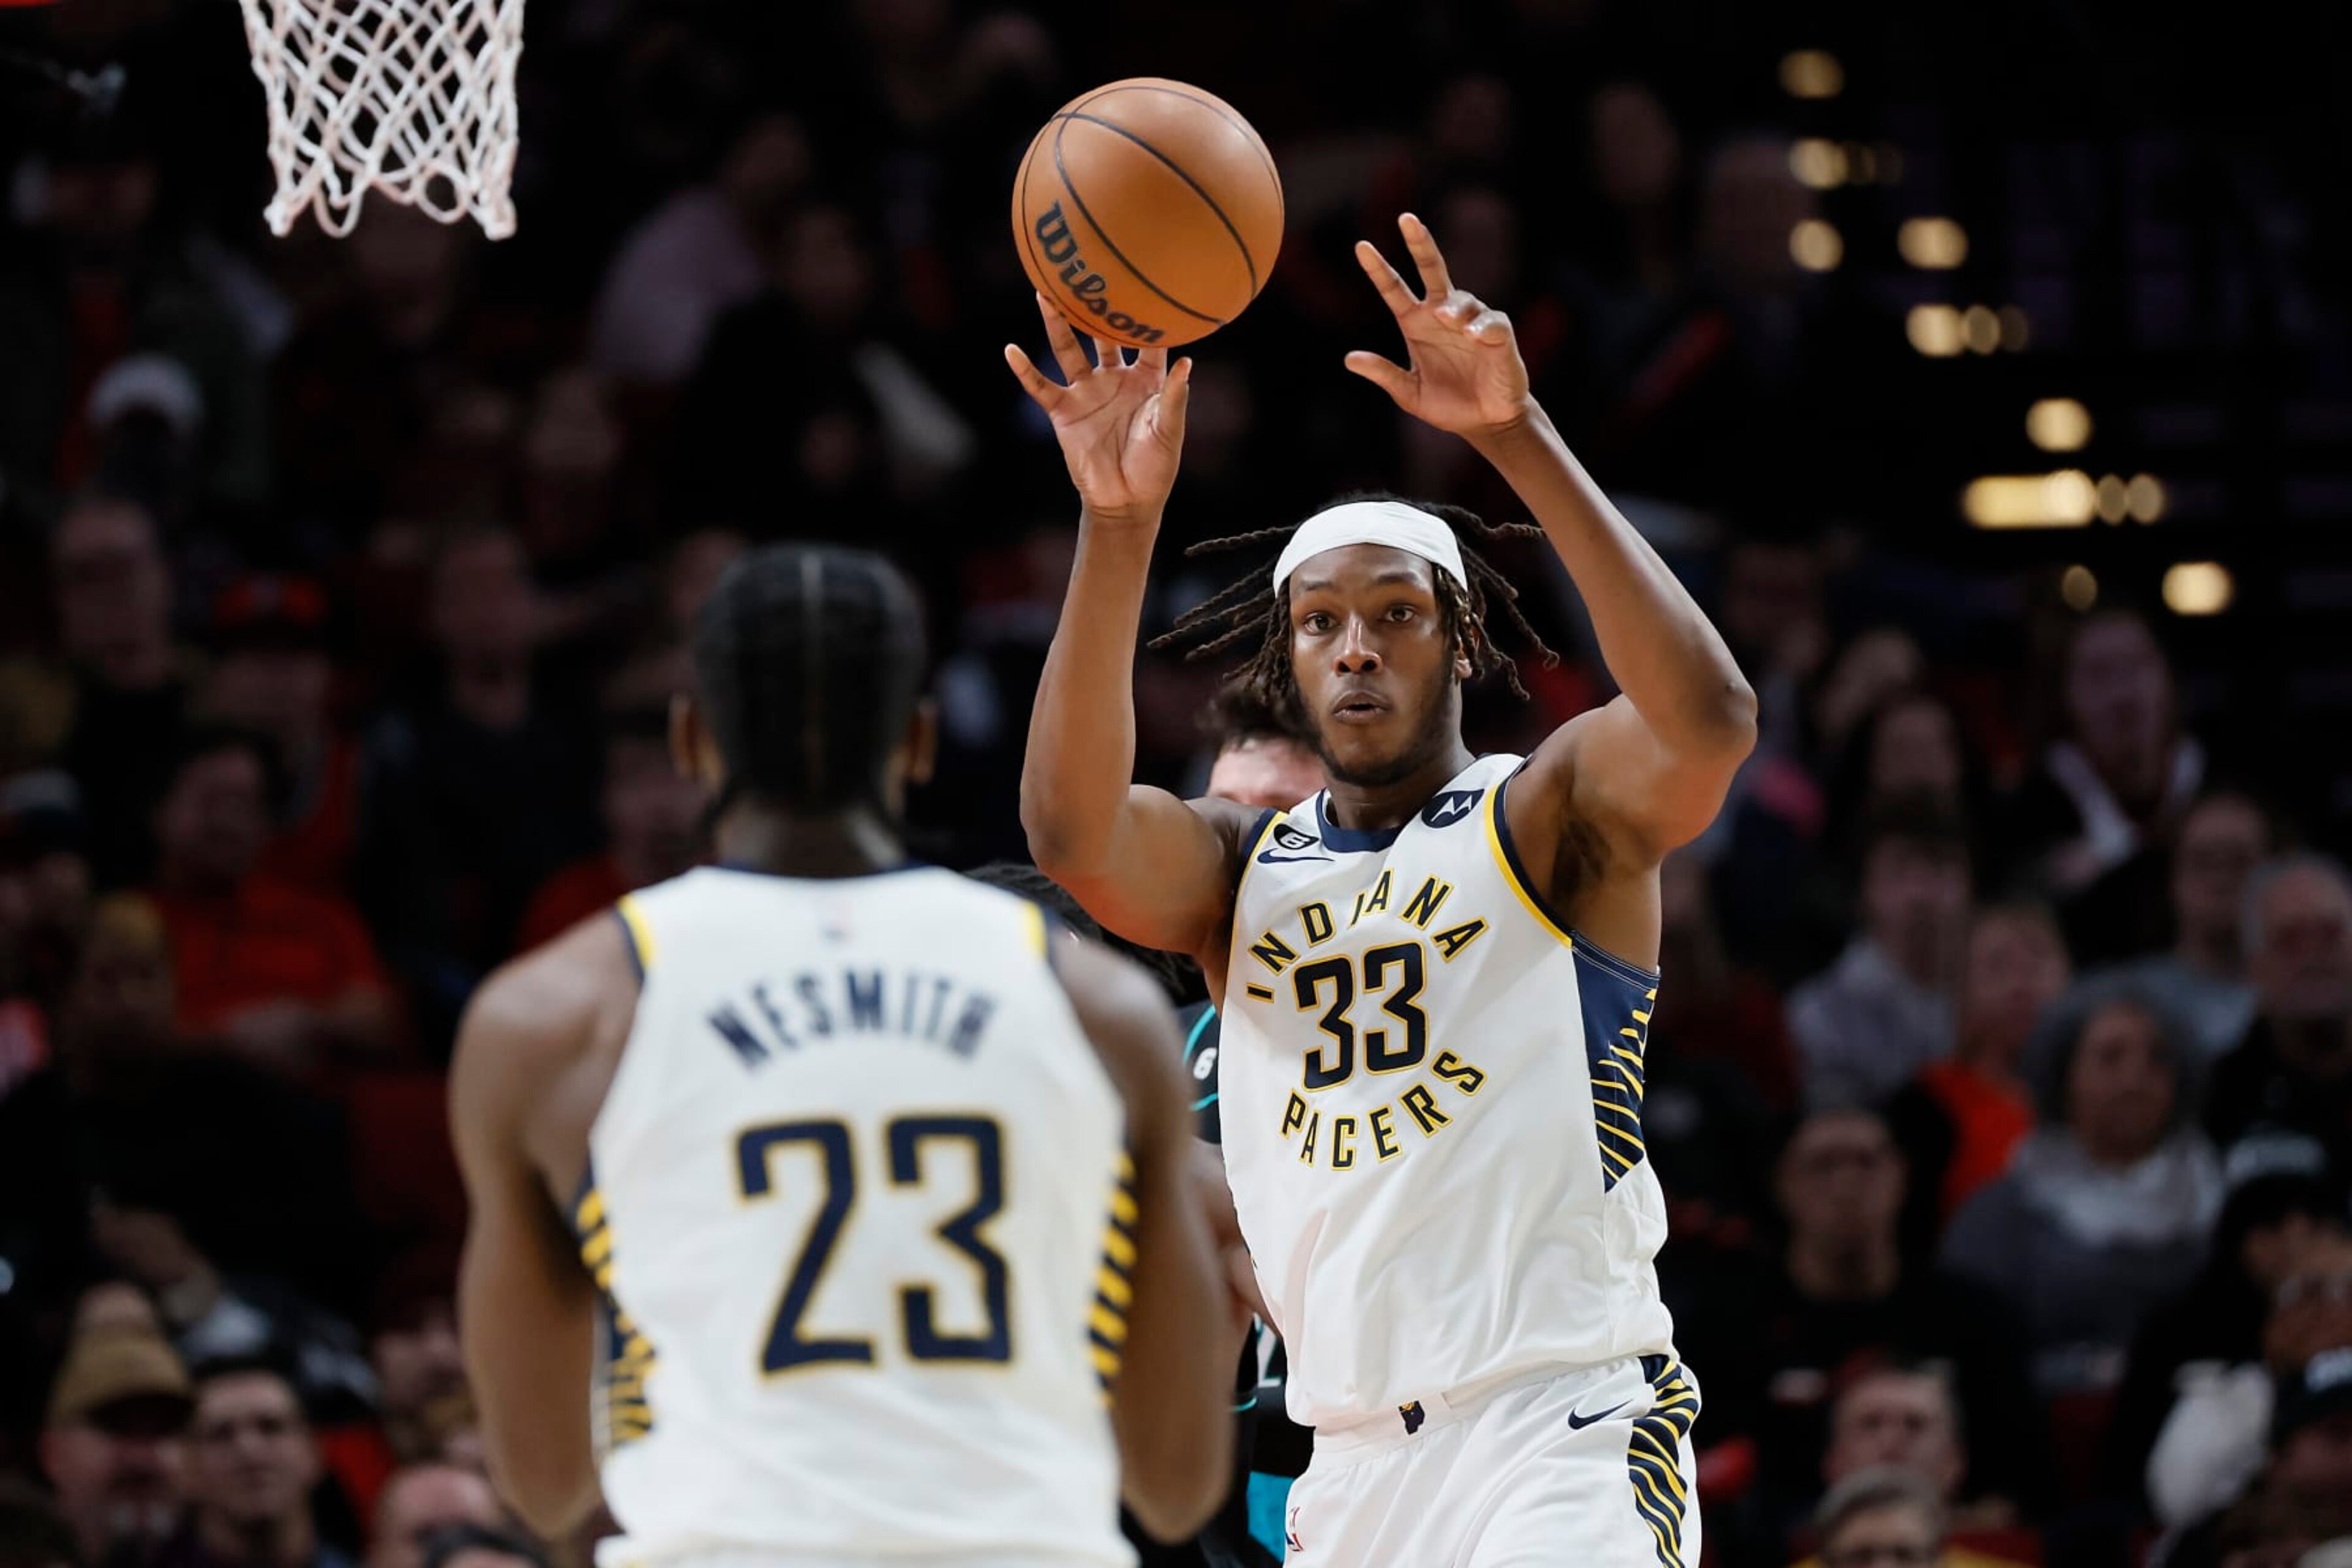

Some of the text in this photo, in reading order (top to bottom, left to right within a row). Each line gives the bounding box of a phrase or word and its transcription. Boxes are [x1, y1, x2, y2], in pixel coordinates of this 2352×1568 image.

[1035, 200, 1165, 343] Wilson
[1246, 868, 1489, 1003] INDIANA
[708, 967, 995, 1073] NESMITH
[1291, 938, 1430, 1093] 33
[1280, 1048, 1487, 1170] PACERS
[733, 1112, 1014, 1376] 23
